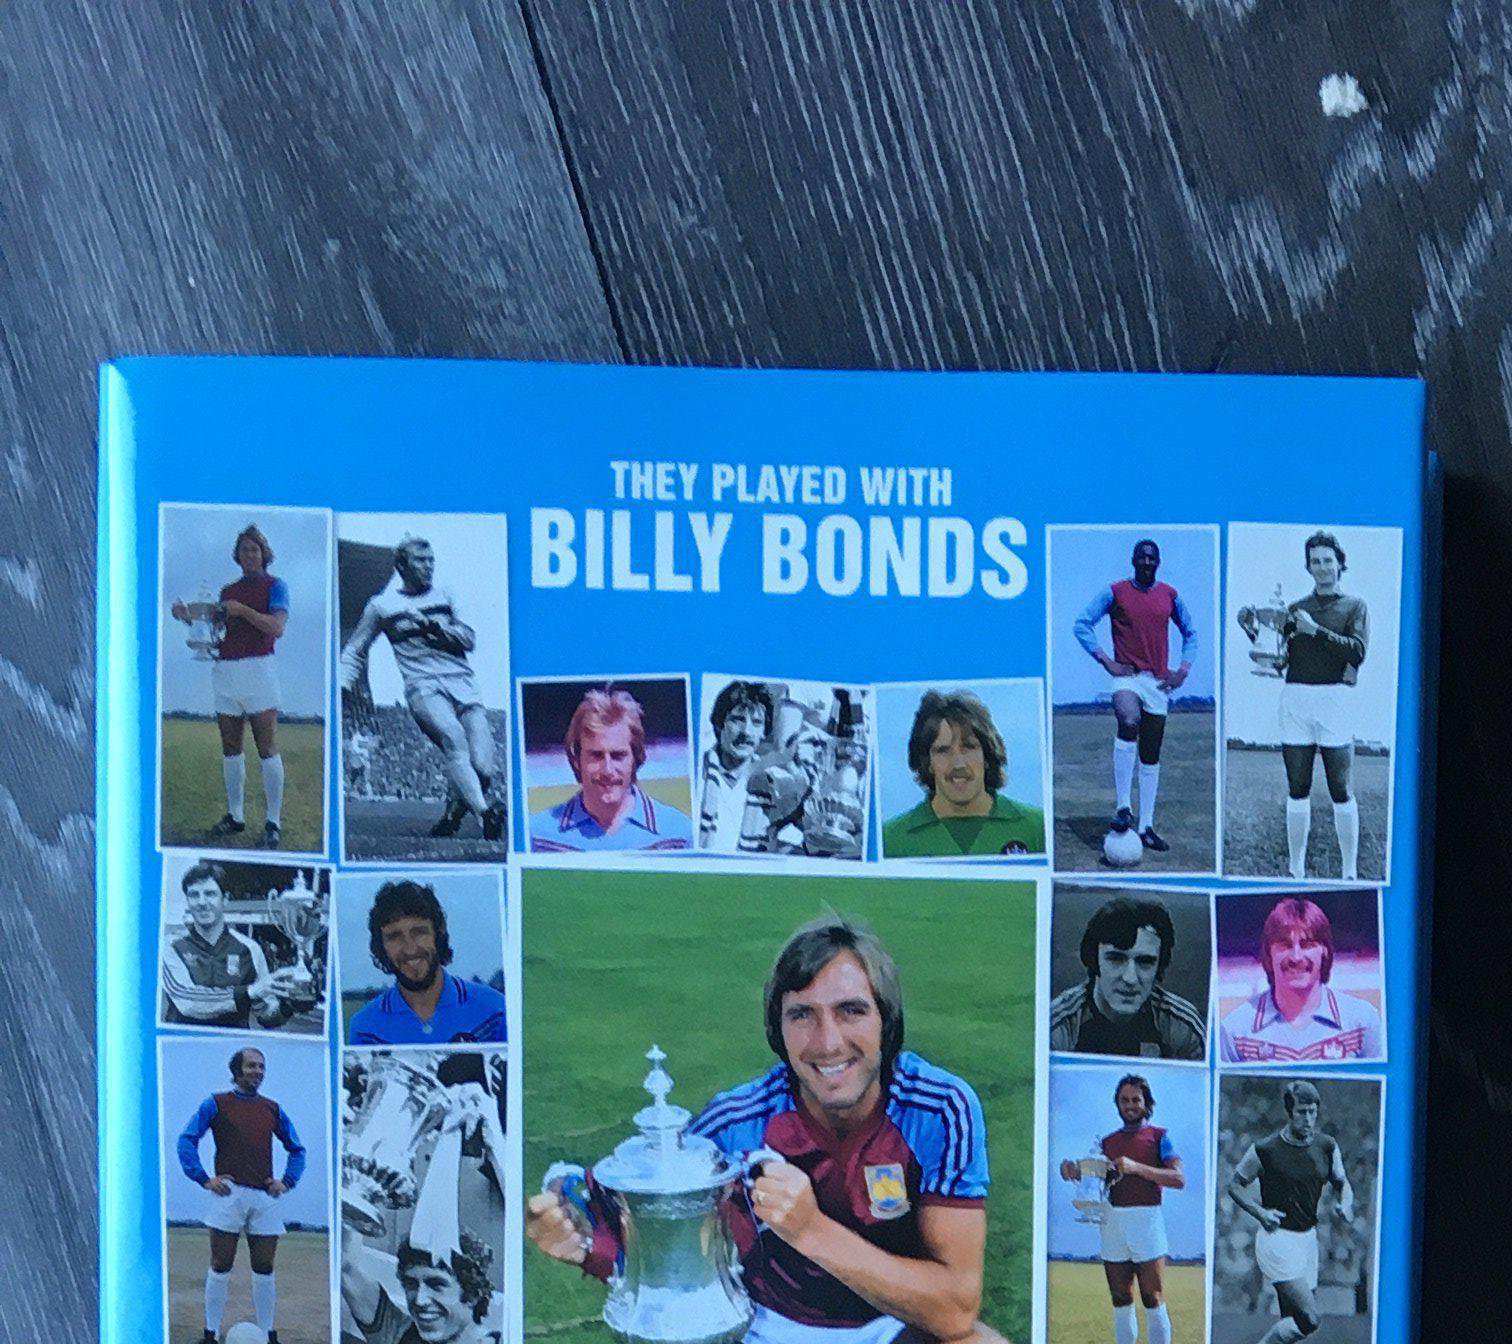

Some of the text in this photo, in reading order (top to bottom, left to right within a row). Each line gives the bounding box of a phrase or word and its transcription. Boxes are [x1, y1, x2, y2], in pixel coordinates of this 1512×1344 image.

[609, 460, 953, 507] THEY PLAYED WITH
[530, 507, 1028, 600] BILLY BONDS
